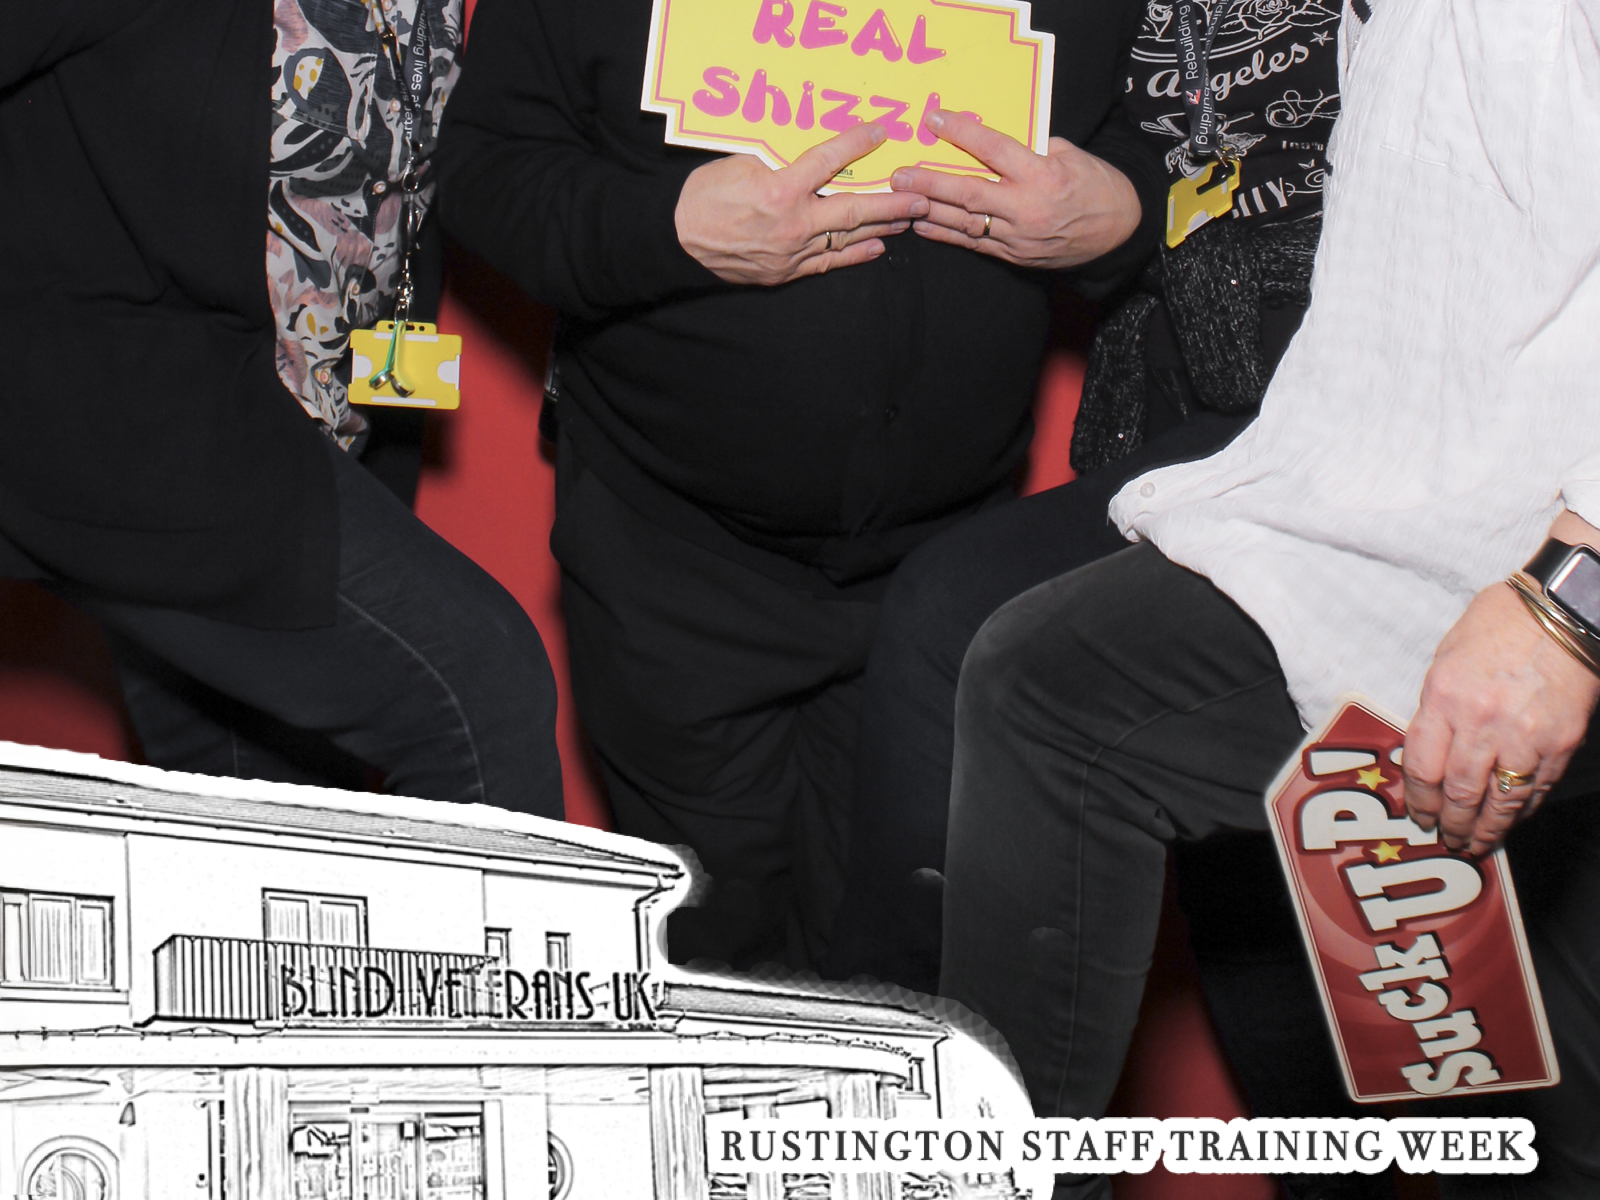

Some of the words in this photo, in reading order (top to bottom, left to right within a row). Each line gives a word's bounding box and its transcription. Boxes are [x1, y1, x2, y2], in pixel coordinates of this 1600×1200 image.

[411, 60, 427, 91] lives
[1147, 43, 1309, 101] Ageles
[1178, 4, 1199, 80] Rebuilding
[1301, 746, 1483, 932] UP!
[1358, 933, 1501, 1096] Suck
